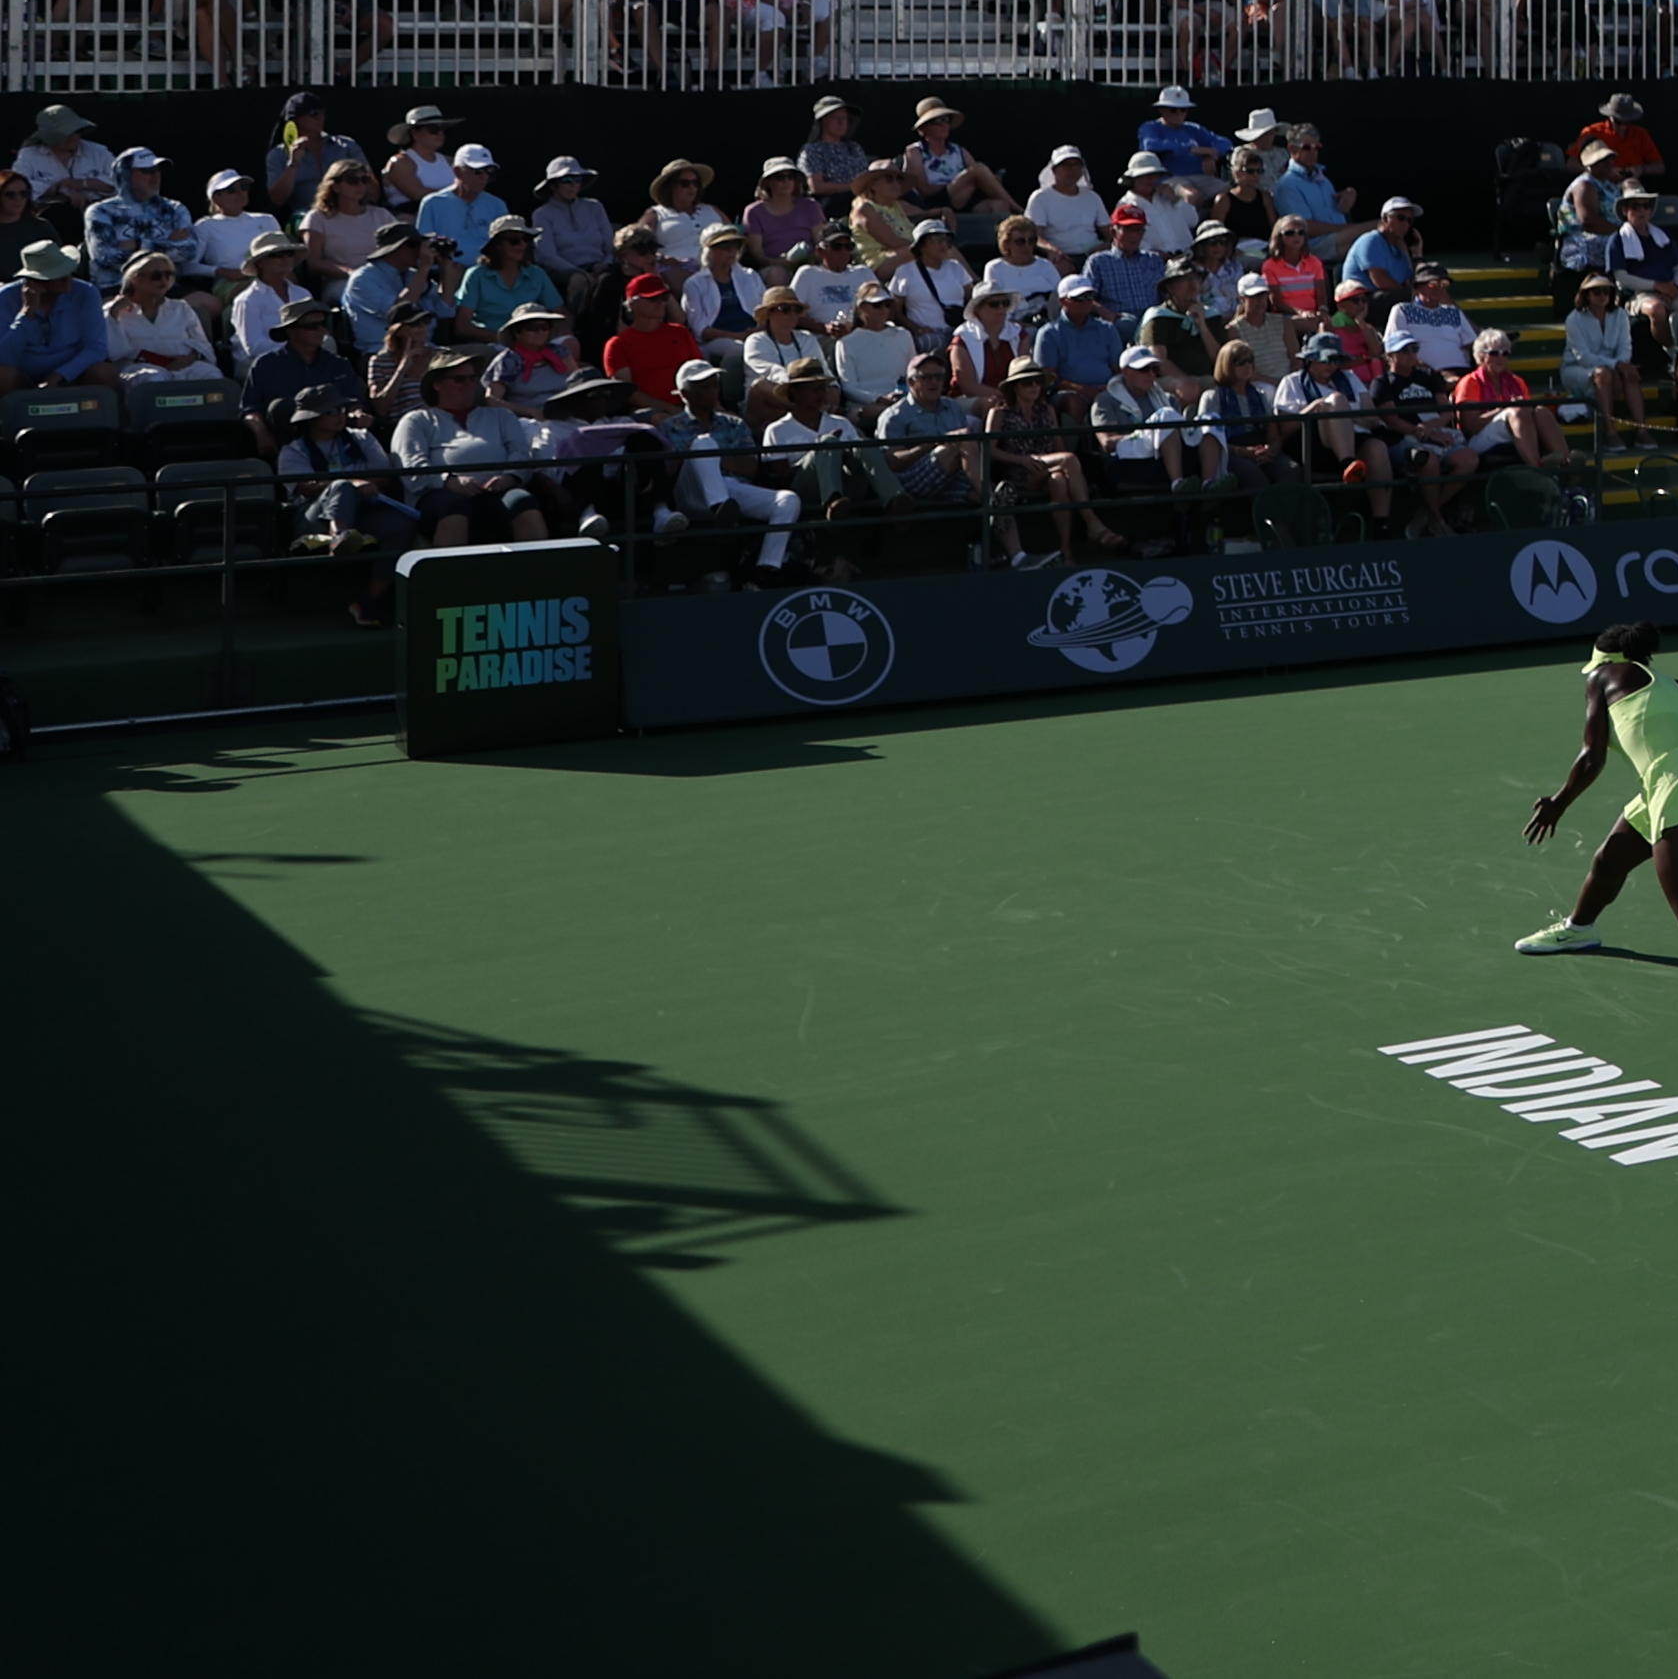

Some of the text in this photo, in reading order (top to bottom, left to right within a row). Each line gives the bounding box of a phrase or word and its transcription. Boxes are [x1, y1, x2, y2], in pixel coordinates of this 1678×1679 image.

[1212, 560, 1402, 602] STEVE FURGAL'S
[436, 595, 590, 655] TENNIS
[773, 594, 873, 630] BMW
[1218, 594, 1407, 622] INTERNATIONAL
[1222, 611, 1411, 641] TENNIS TOURS
[436, 644, 592, 694] PARADISE
